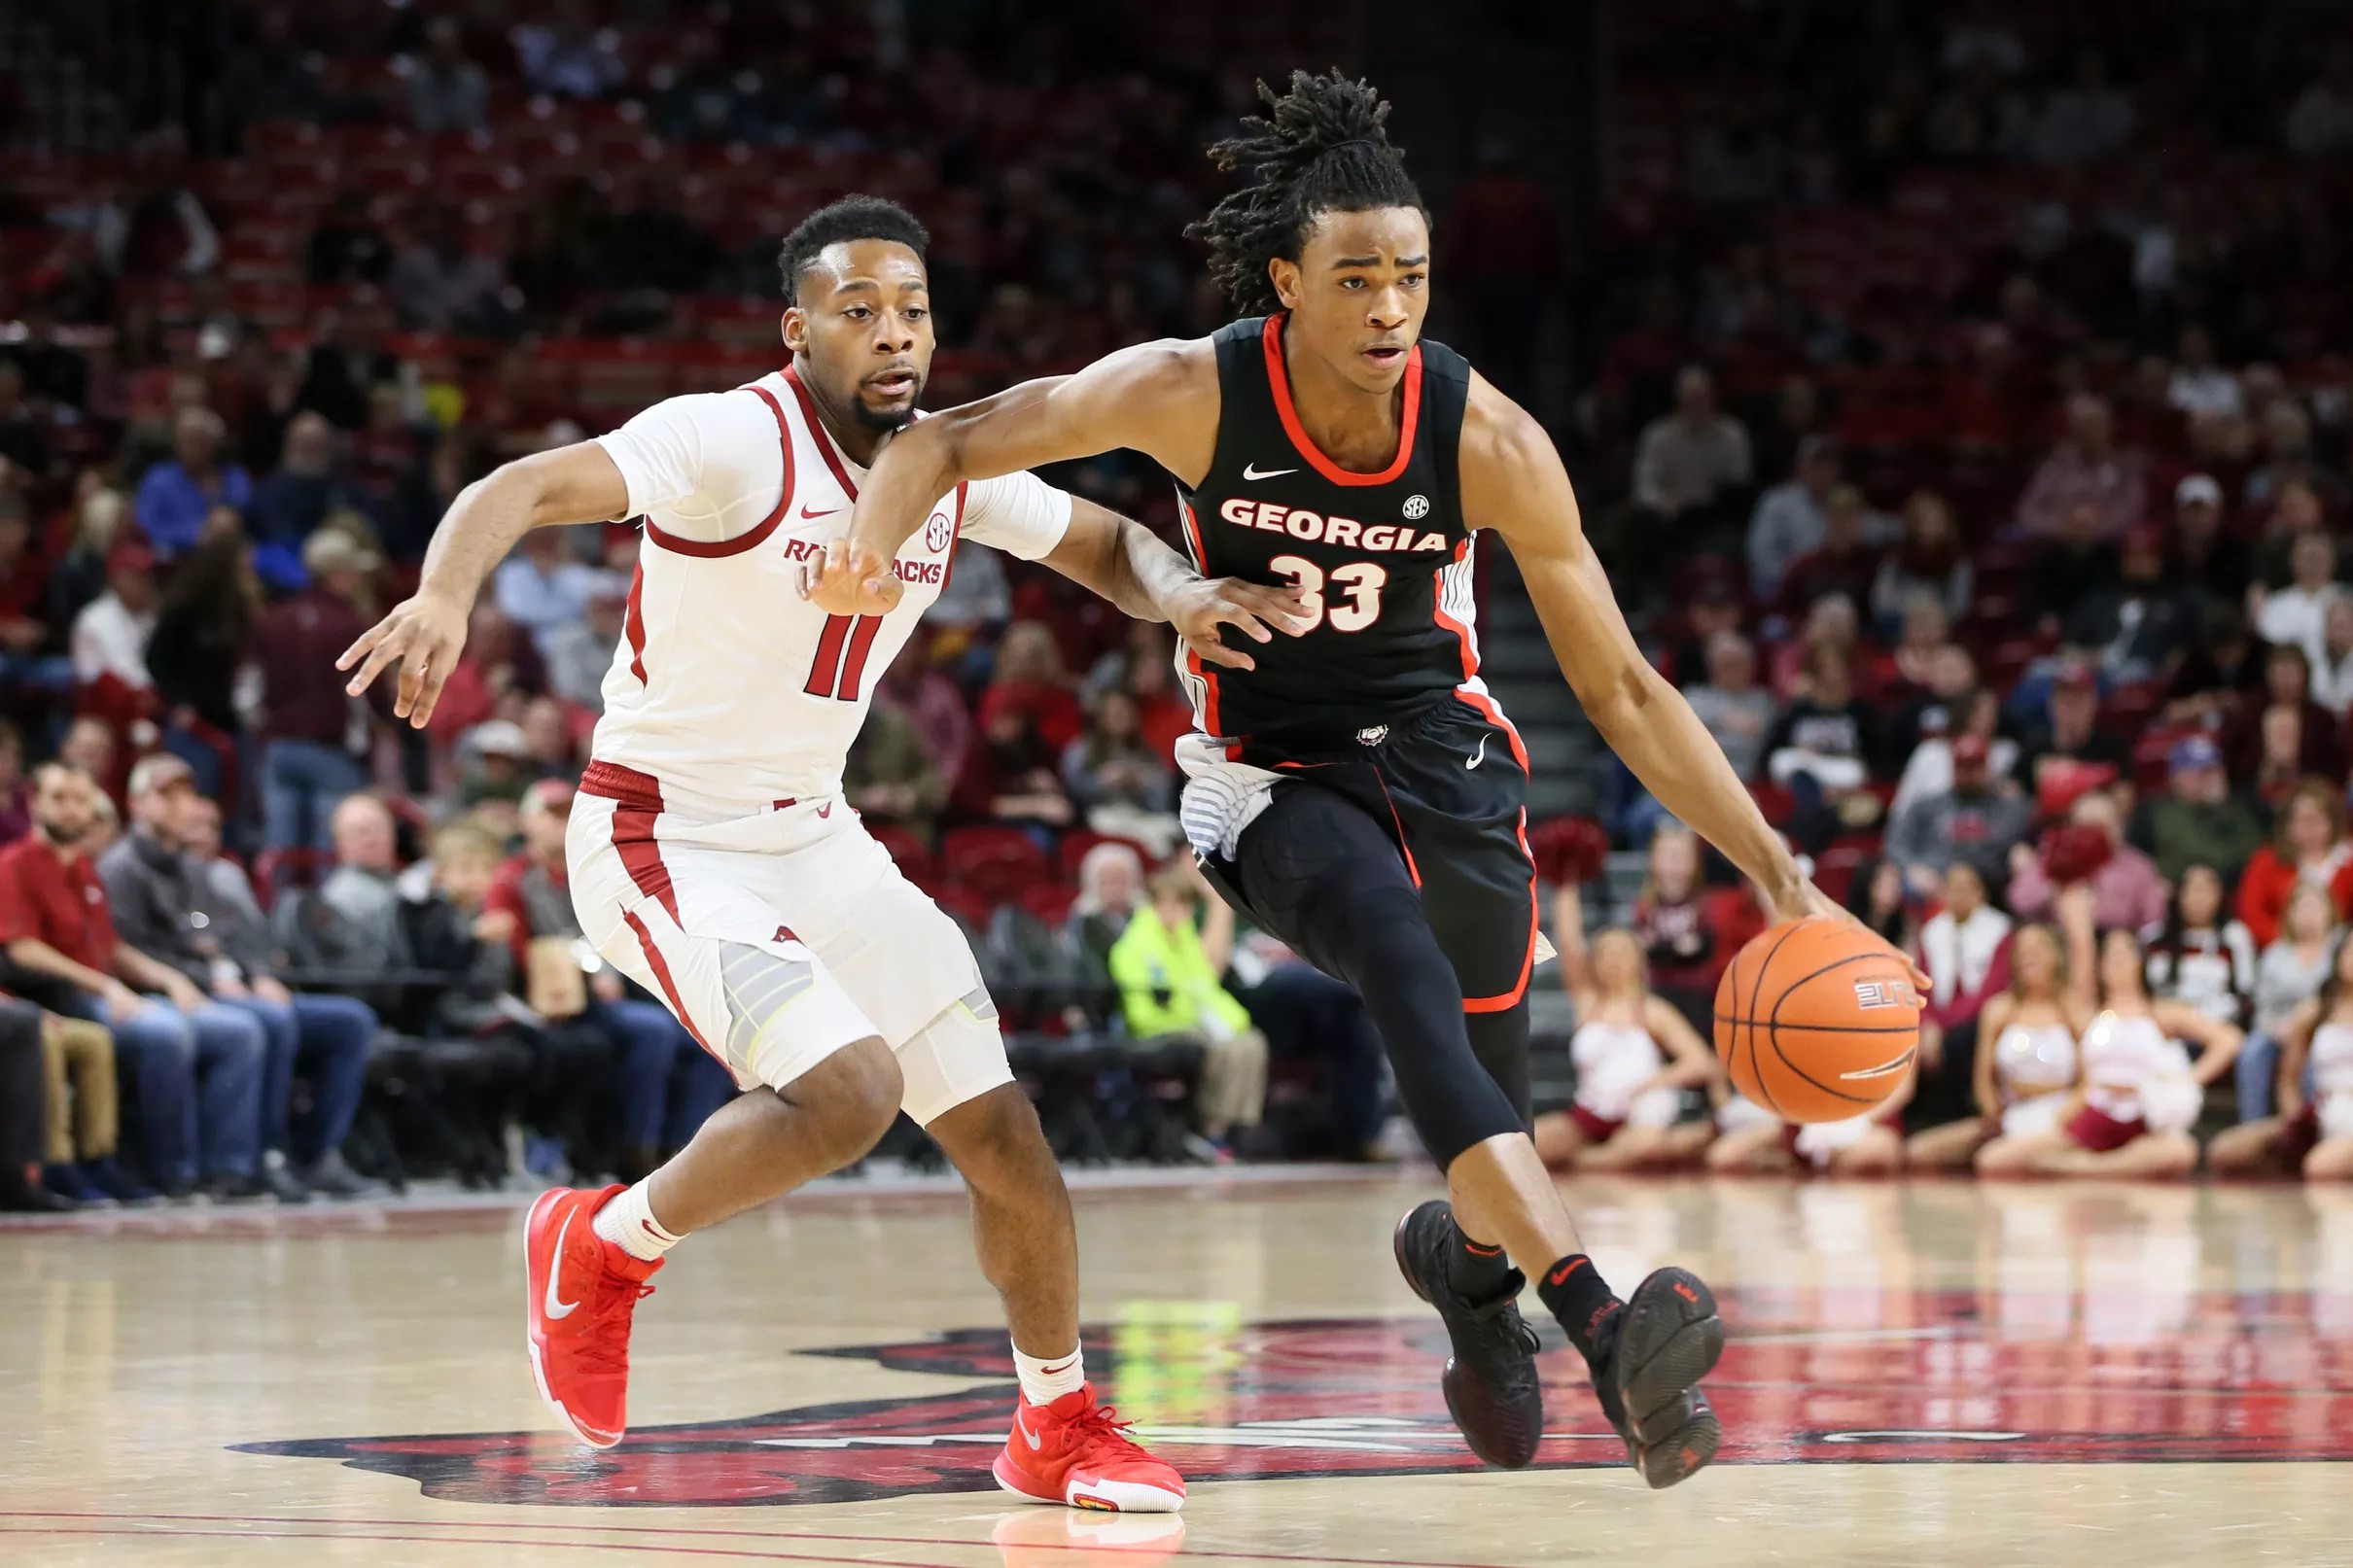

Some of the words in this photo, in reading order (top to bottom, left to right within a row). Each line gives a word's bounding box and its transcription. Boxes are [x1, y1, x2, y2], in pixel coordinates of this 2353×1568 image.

[1220, 498, 1448, 552] GEORGIA
[1405, 497, 1426, 517] SEC
[1270, 554, 1388, 633] 33
[803, 613, 884, 701] 11
